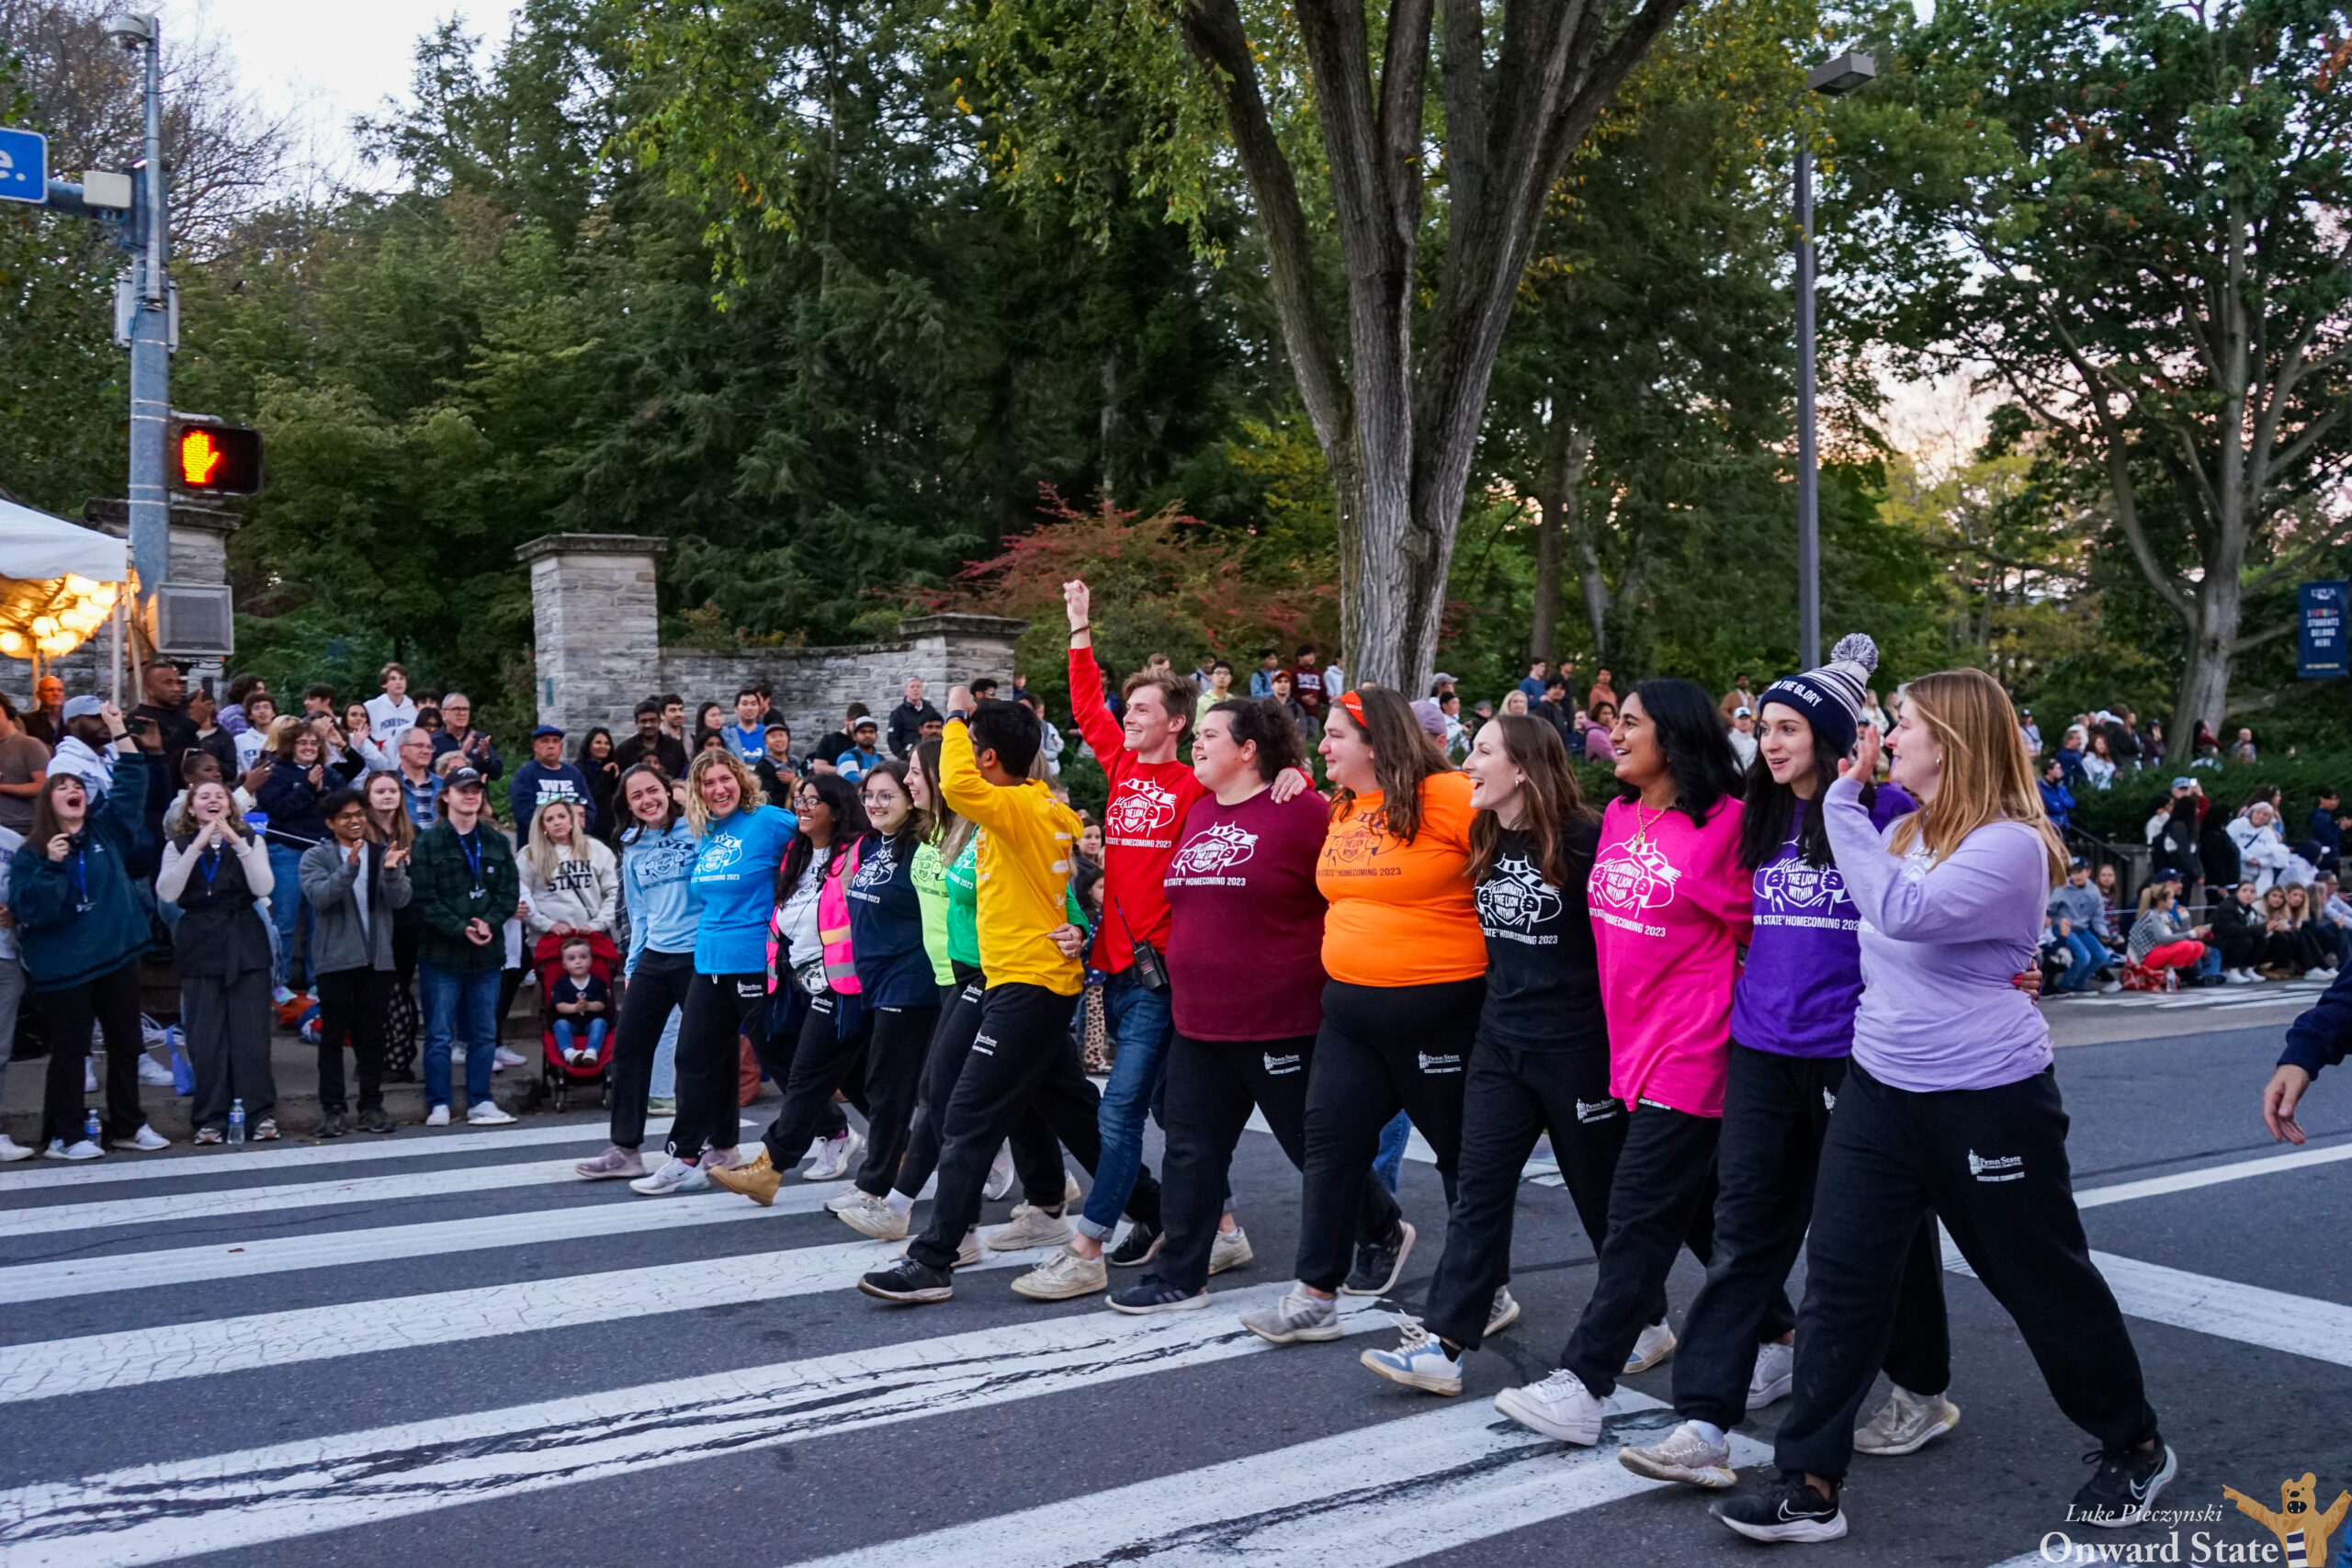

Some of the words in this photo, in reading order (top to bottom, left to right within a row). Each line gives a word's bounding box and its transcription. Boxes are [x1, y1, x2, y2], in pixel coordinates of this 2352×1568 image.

[1779, 681, 1798, 692] THE
[1793, 684, 1823, 707] GLORY
[538, 778, 575, 792] WE
[1122, 838, 1155, 848] HOMECOMING
[1155, 840, 1172, 849] 2023
[1338, 868, 1377, 876] HOMECOMING
[1379, 867, 1402, 876] 2023
[1606, 863, 1642, 879] ILLUMINATE
[547, 874, 593, 892] STATE
[960, 878, 974, 890] 2023
[1185, 876, 1226, 886] HOMECOMING
[1227, 877, 1246, 886] 2023
[1607, 873, 1620, 886] THE
[1617, 874, 1634, 888] LION
[1788, 873, 1801, 886] THE
[1801, 873, 1818, 886] LION
[1491, 882, 1523, 897] ILLUMINATE
[1606, 883, 1627, 901] WITHIN
[1789, 885, 1813, 901] WITHIN
[867, 894, 880, 904] 2023
[1494, 893, 1505, 907] THE
[1505, 895, 1519, 908] LION
[1496, 904, 1516, 919] WITHIN
[1763, 915, 1782, 926] STATE
[1785, 916, 1839, 929] HOMECOMING
[1842, 919, 1860, 931] 202
[1482, 927, 1497, 938] TATE
[1499, 929, 1537, 945] HOMECOMING
[1538, 935, 1558, 944] 2023
[1644, 925, 1666, 937] 2023
[1979, 1157, 2000, 1167] Penn
[2000, 1156, 2022, 1165] State
